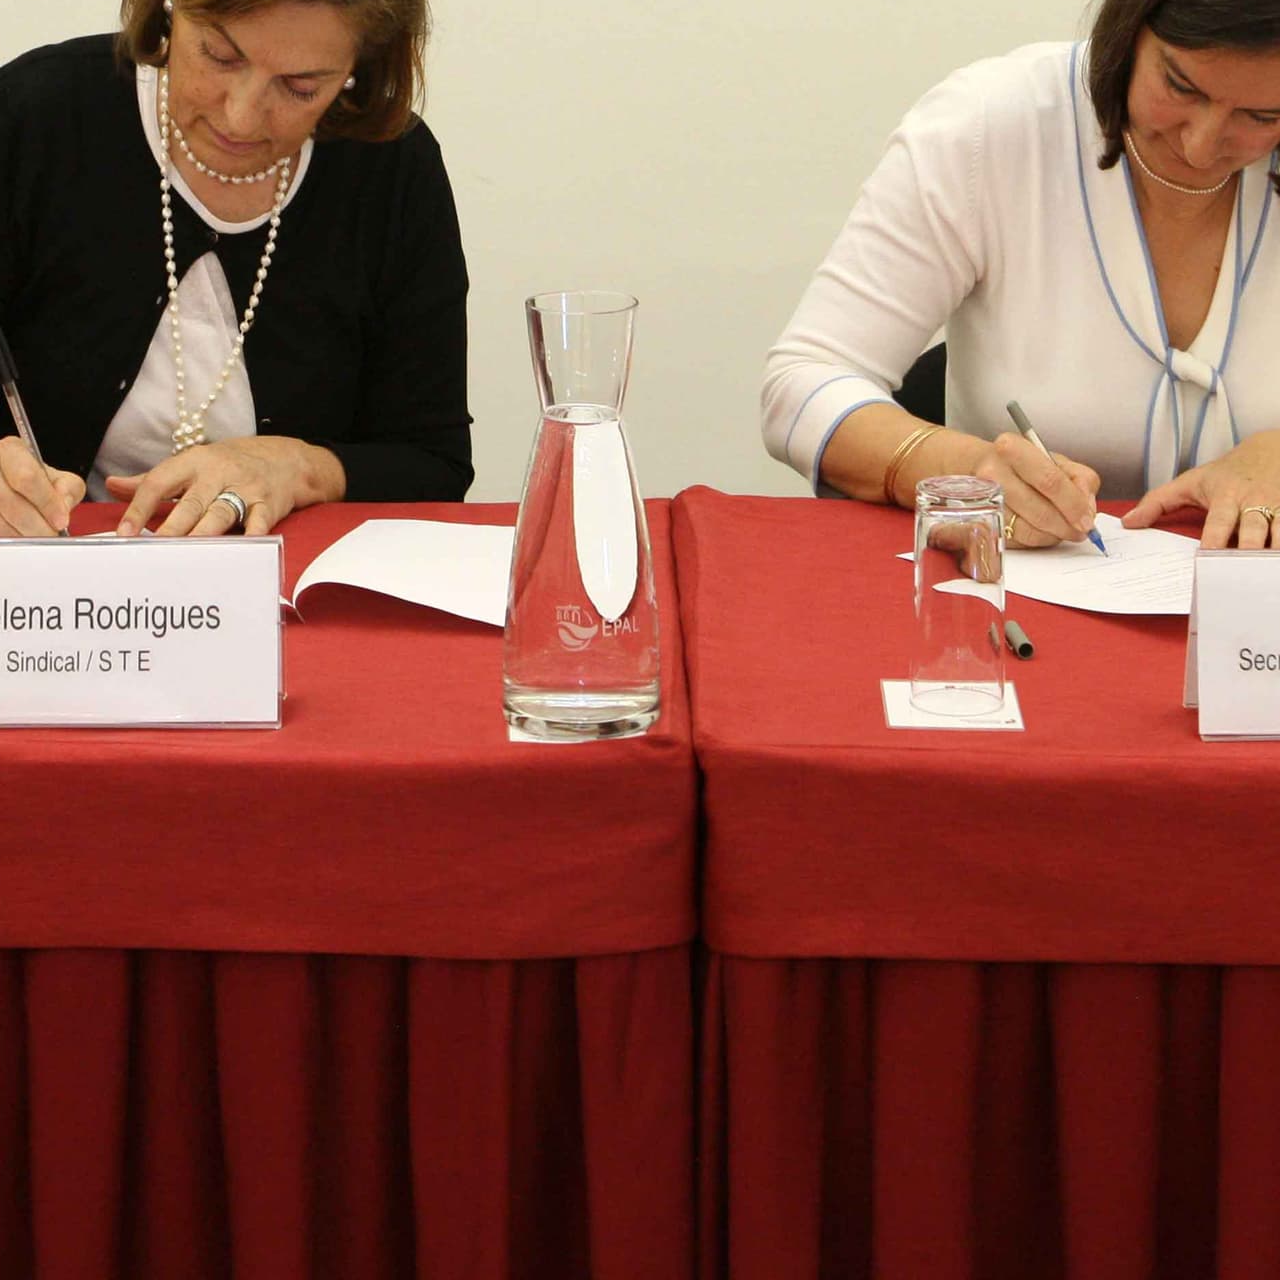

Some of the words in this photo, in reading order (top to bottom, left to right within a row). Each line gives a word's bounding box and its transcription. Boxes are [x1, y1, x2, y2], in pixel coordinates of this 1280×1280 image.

[74, 597, 221, 638] Rodrigues
[601, 615, 640, 637] EPAL
[6, 650, 80, 672] Sindical
